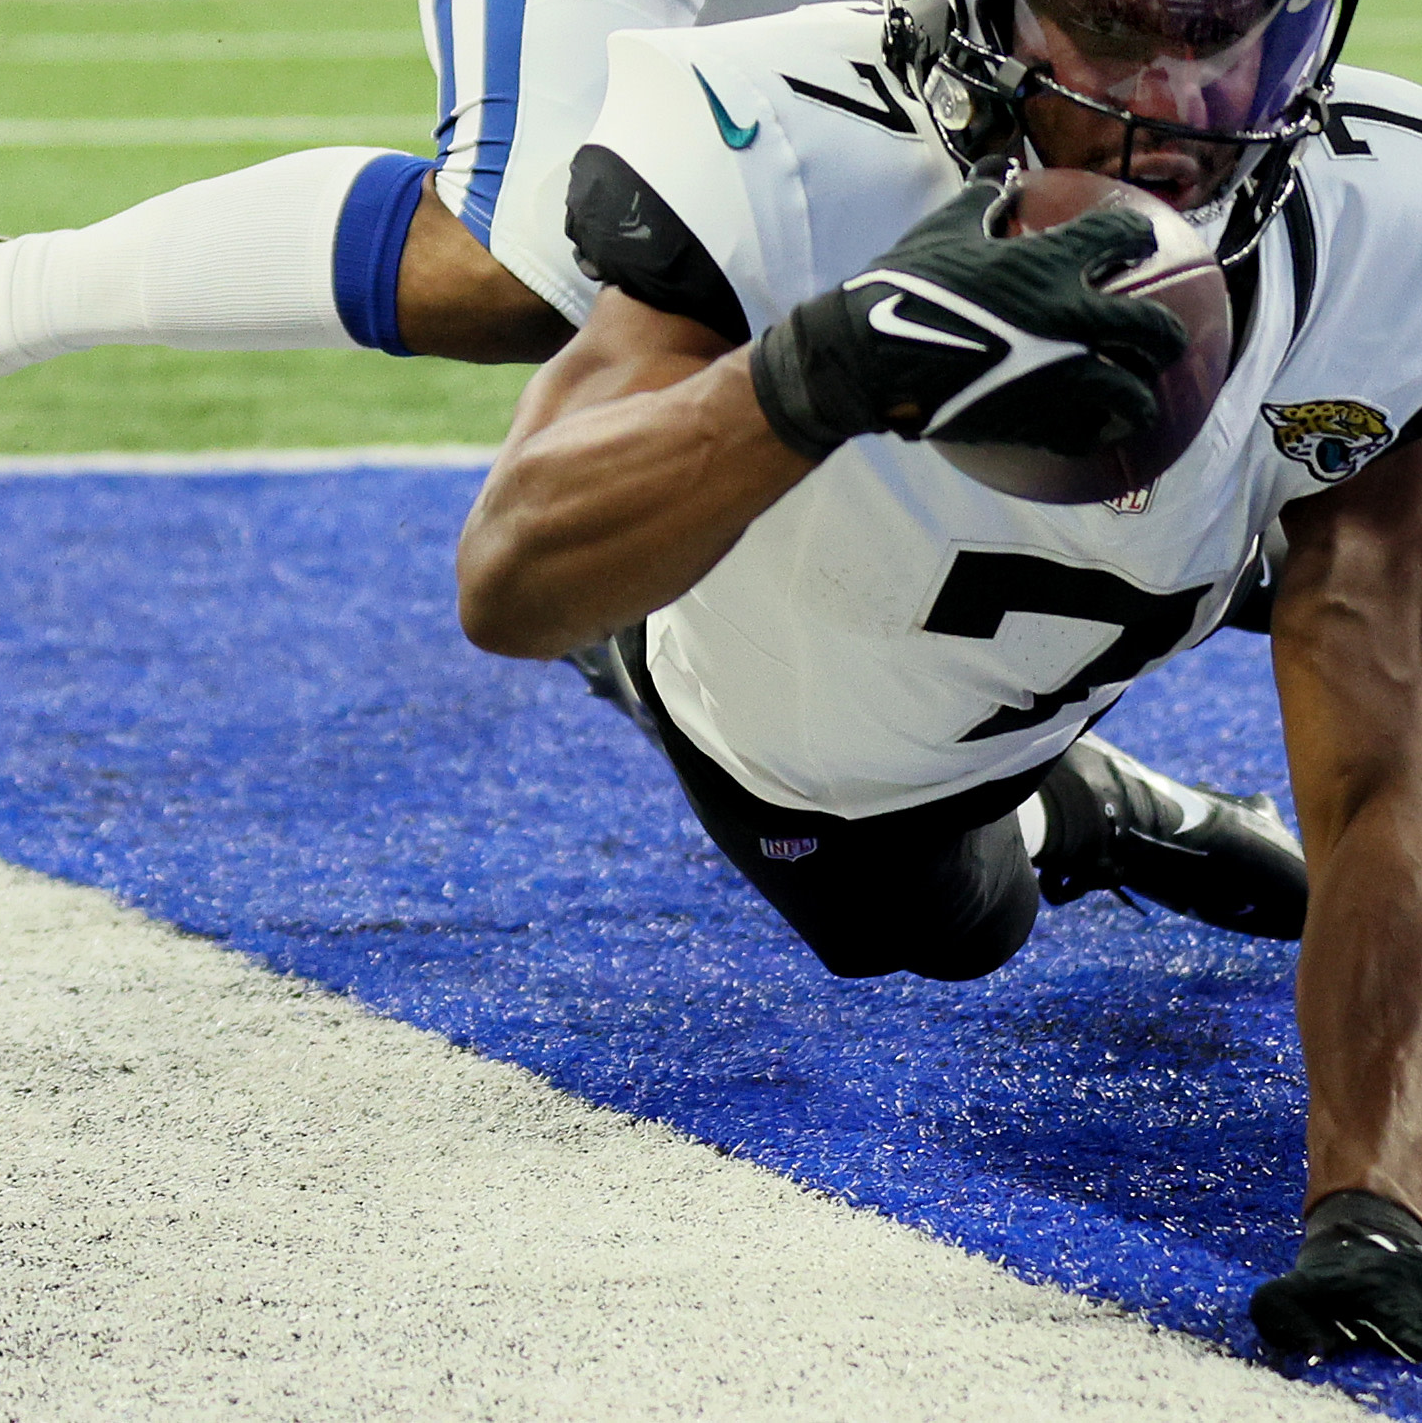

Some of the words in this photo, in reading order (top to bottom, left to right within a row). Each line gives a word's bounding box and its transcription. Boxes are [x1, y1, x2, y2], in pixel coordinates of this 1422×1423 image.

[778, 60, 918, 135] 7
[922, 549, 1215, 744] 7
[773, 838, 812, 857] NFL
